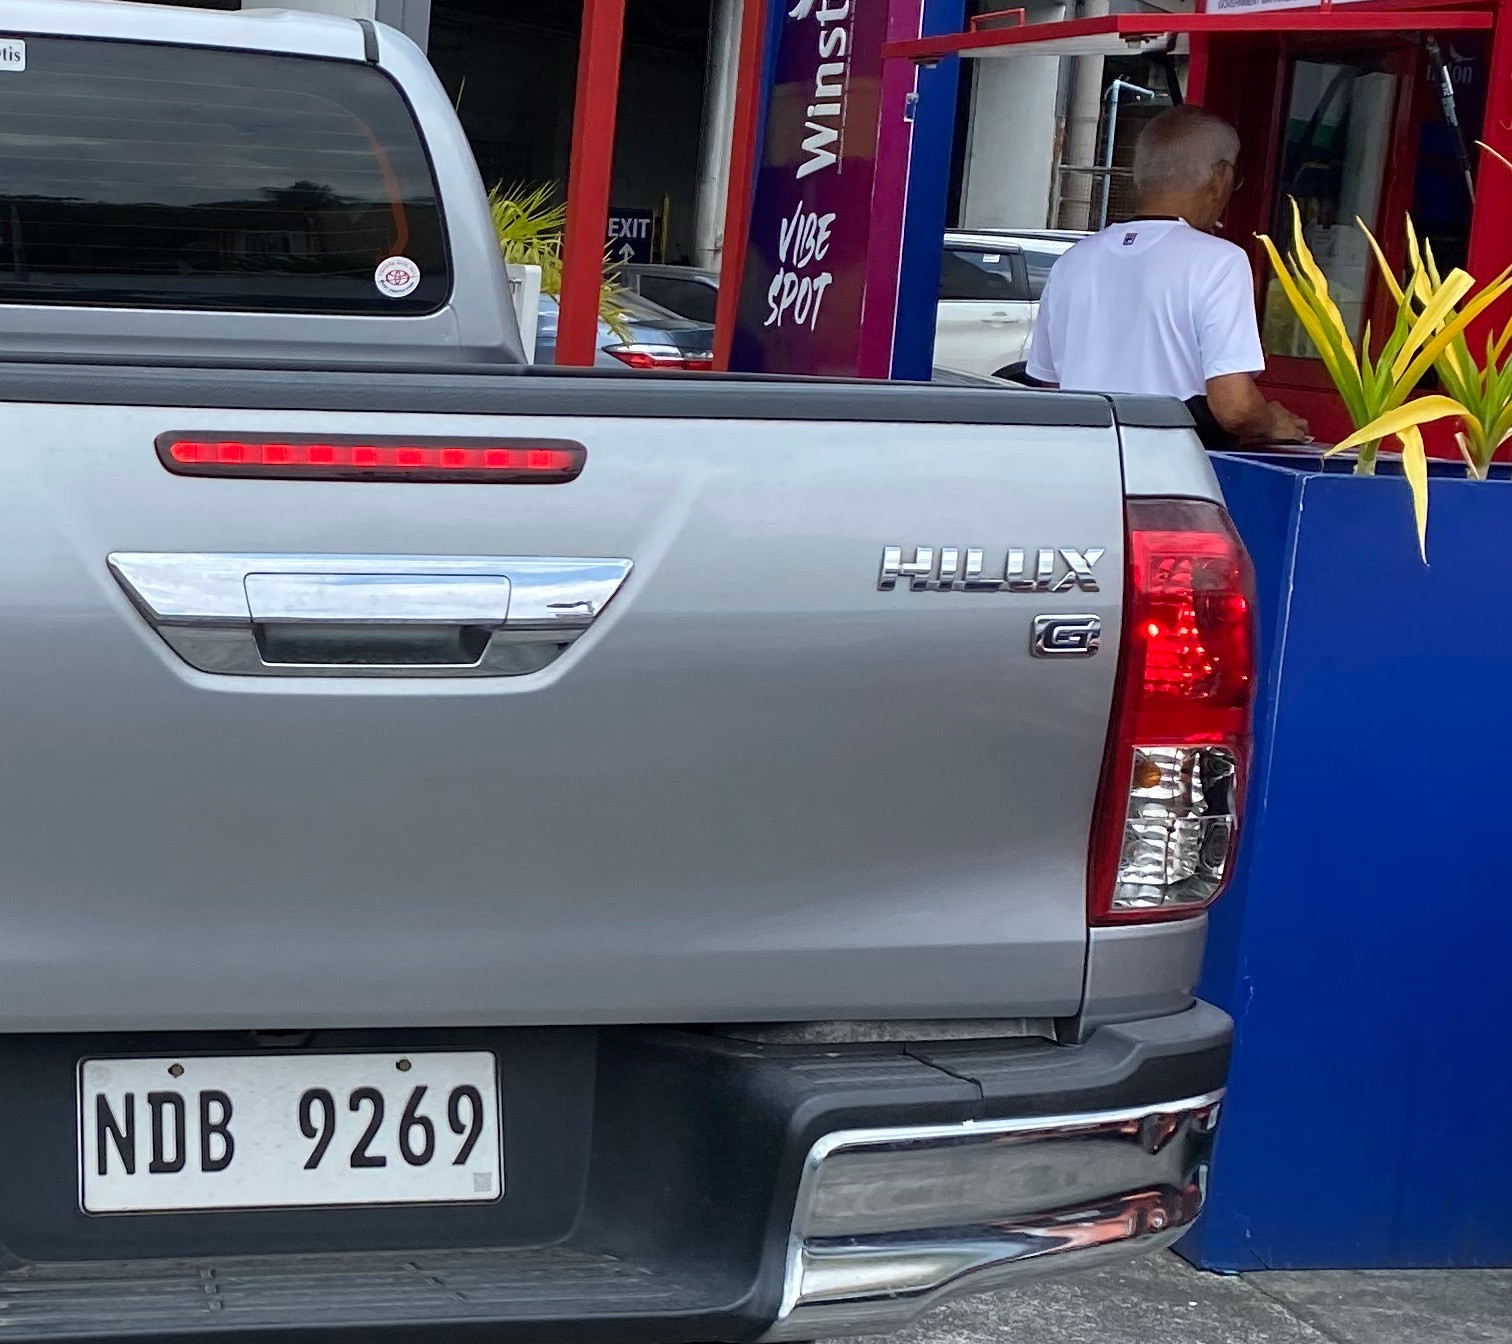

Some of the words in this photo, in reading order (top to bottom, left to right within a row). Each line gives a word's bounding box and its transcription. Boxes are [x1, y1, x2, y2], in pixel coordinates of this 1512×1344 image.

[608, 217, 651, 239] EXIT
[780, 200, 837, 269] VIBE
[764, 267, 833, 331] SPOT
[876, 546, 1106, 592] HILUX
[1032, 613, 1101, 659] G
[96, 1089, 235, 1176] NDB
[298, 1084, 485, 1171] 9269
